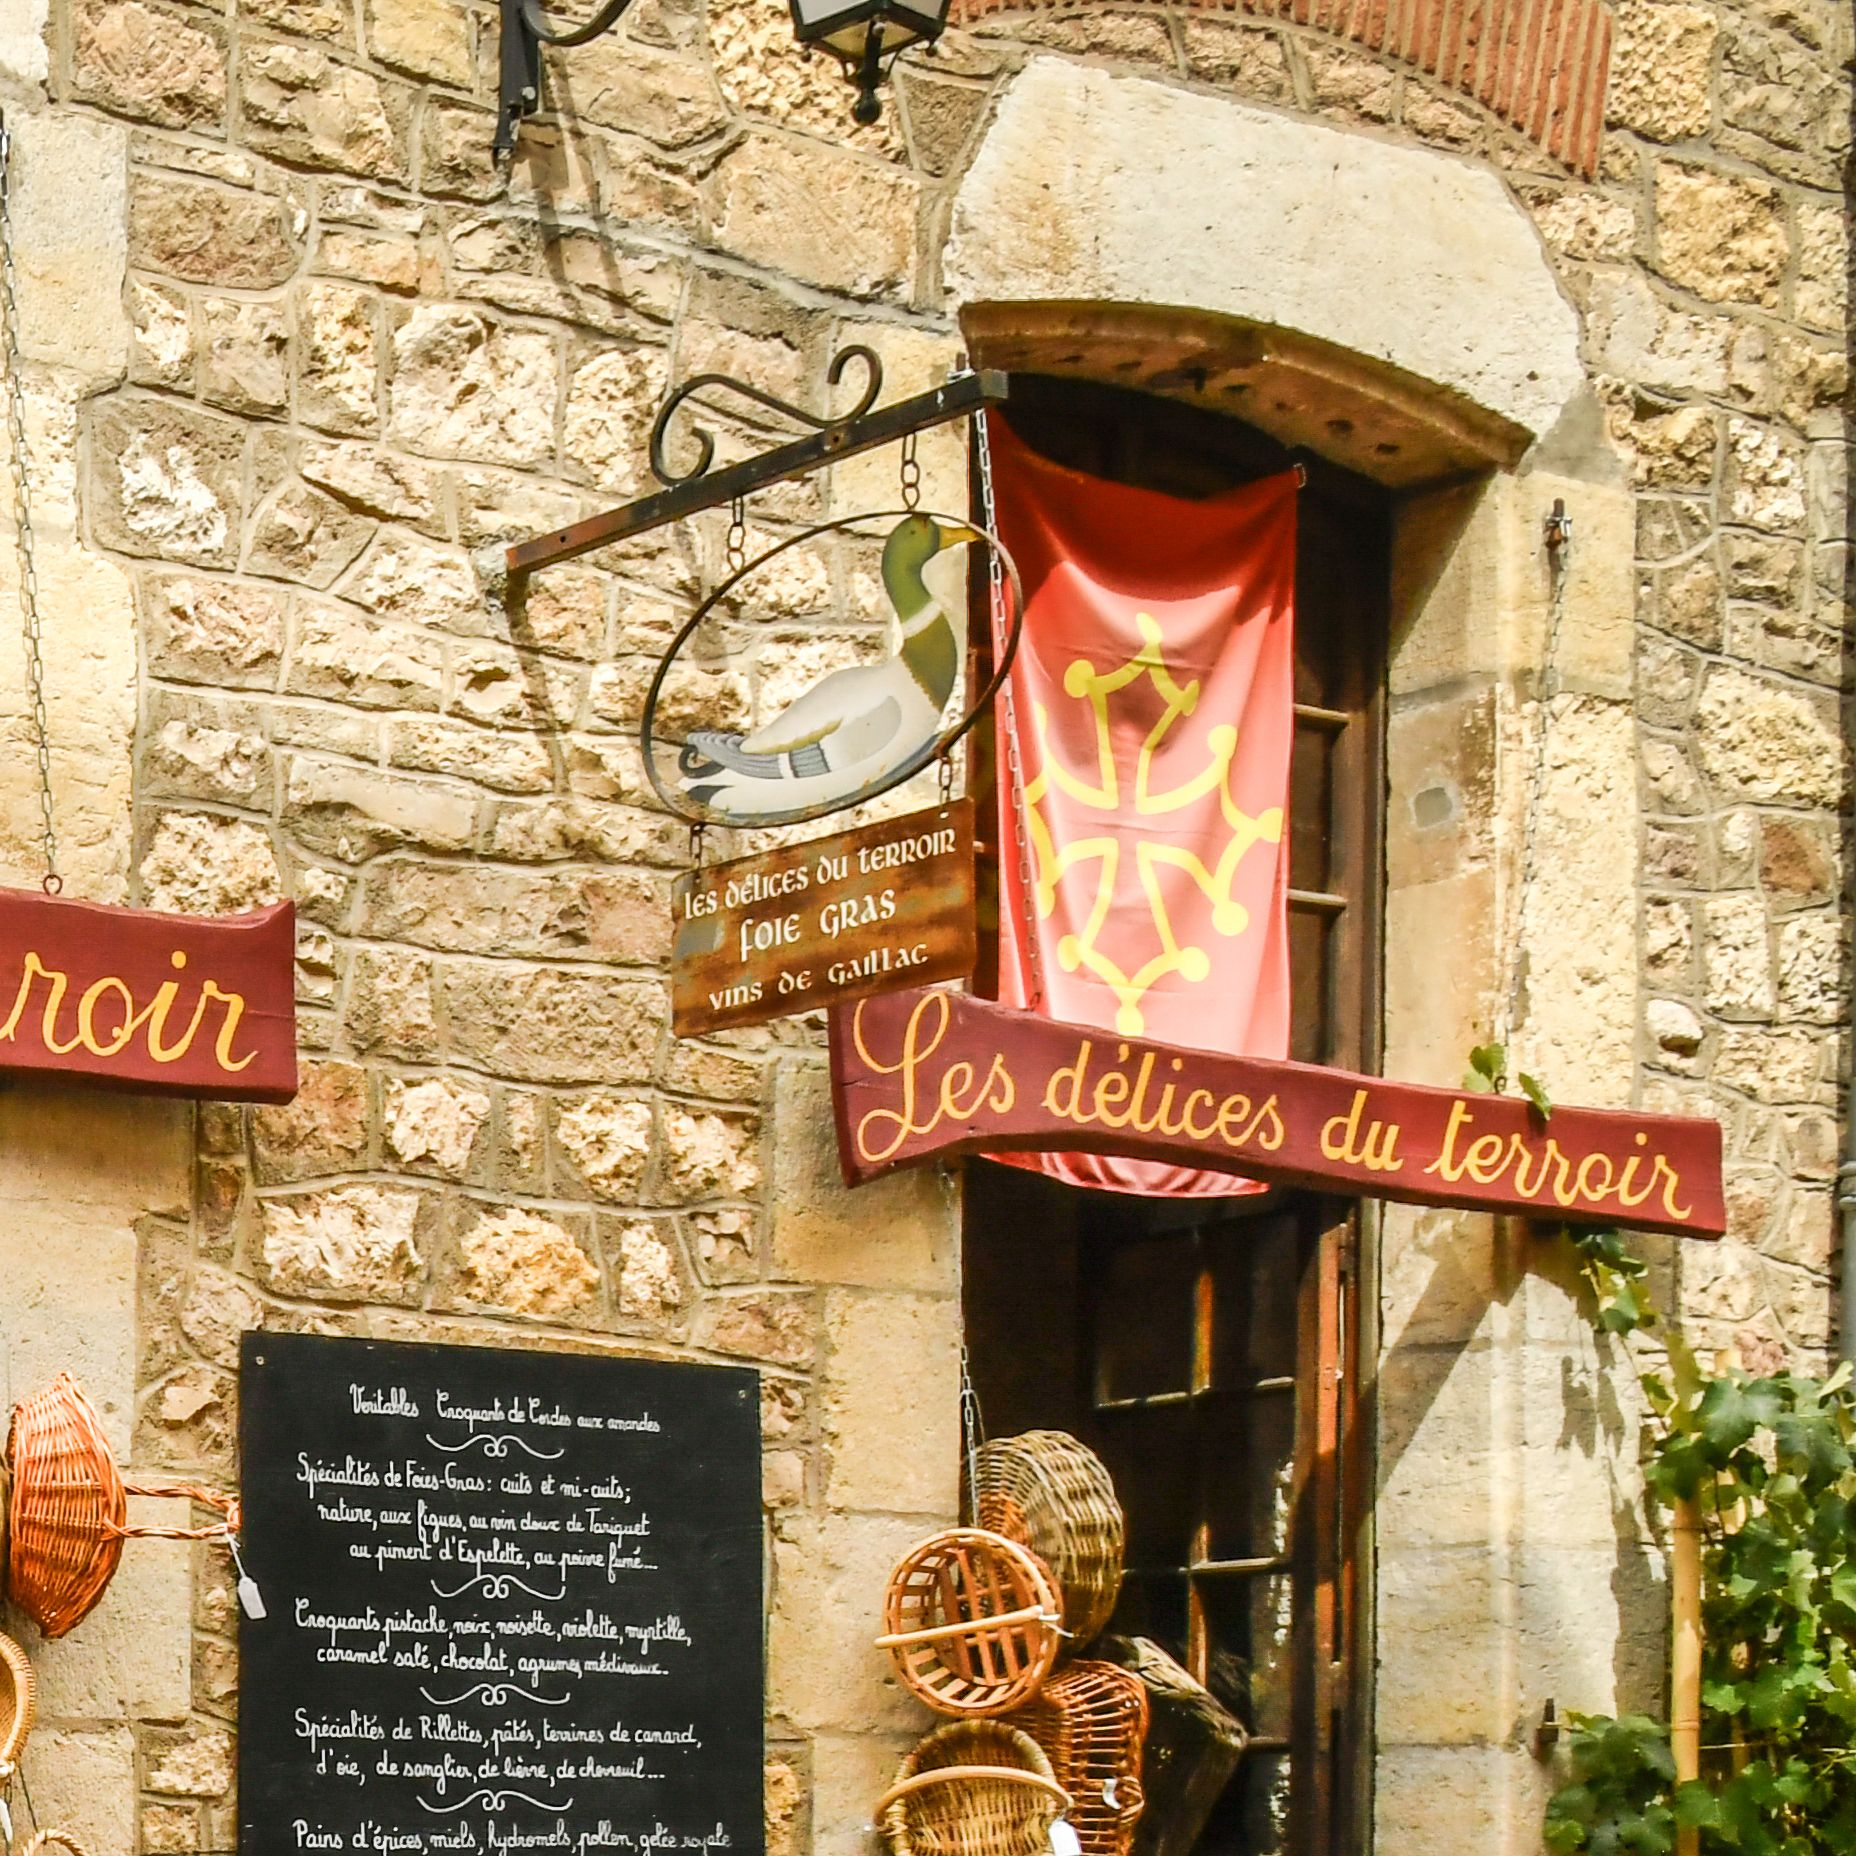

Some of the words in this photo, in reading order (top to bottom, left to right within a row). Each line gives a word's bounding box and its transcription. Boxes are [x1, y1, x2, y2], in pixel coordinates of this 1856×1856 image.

[853, 991, 1016, 1162] Les
[1041, 1039, 1285, 1151] délices
[1320, 1089, 1404, 1171] du
[1424, 1100, 1692, 1220] terroir
[436, 1388, 506, 1433] Croquants
[528, 1396, 572, 1427] Cordes
[577, 1416, 604, 1429] aux
[607, 1412, 661, 1432] amandes
[296, 1452, 380, 1499] Spécialités
[500, 1472, 533, 1494] cuits
[540, 1474, 555, 1495] et
[317, 1497, 378, 1531] nature,
[417, 1499, 467, 1543] figues,
[469, 1515, 488, 1529] au
[491, 1509, 517, 1531] vin
[520, 1511, 560, 1532] doux
[585, 1507, 650, 1549] Tariquet
[349, 1543, 371, 1558] au
[375, 1539, 432, 1572] piment
[439, 1535, 530, 1577] d'Espelette,
[295, 1597, 381, 1647] Croquants
[383, 1605, 453, 1647] pistache,
[453, 1613, 496, 1640] noix,
[496, 1609, 561, 1642] noisette,
[562, 1608, 624, 1645] violette,
[625, 1614, 691, 1655] myrtille,
[317, 1641, 387, 1664] caramel
[393, 1641, 439, 1674] salé,
[440, 1641, 515, 1677] chocolat,
[295, 1707, 385, 1753] Spécialités
[392, 1718, 413, 1740] de
[419, 1713, 489, 1749] Rillettes,
[491, 1719, 541, 1757] pâtés,
[543, 1718, 604, 1743] terrines
[634, 1723, 702, 1748] canard,
[376, 1749, 399, 1776] de
[403, 1753, 477, 1795] sanglier,
[504, 1755, 555, 1787] lièvre,
[556, 1759, 577, 1778] de
[292, 1818, 343, 1849] Pains
[430, 1820, 484, 1856] miels,
